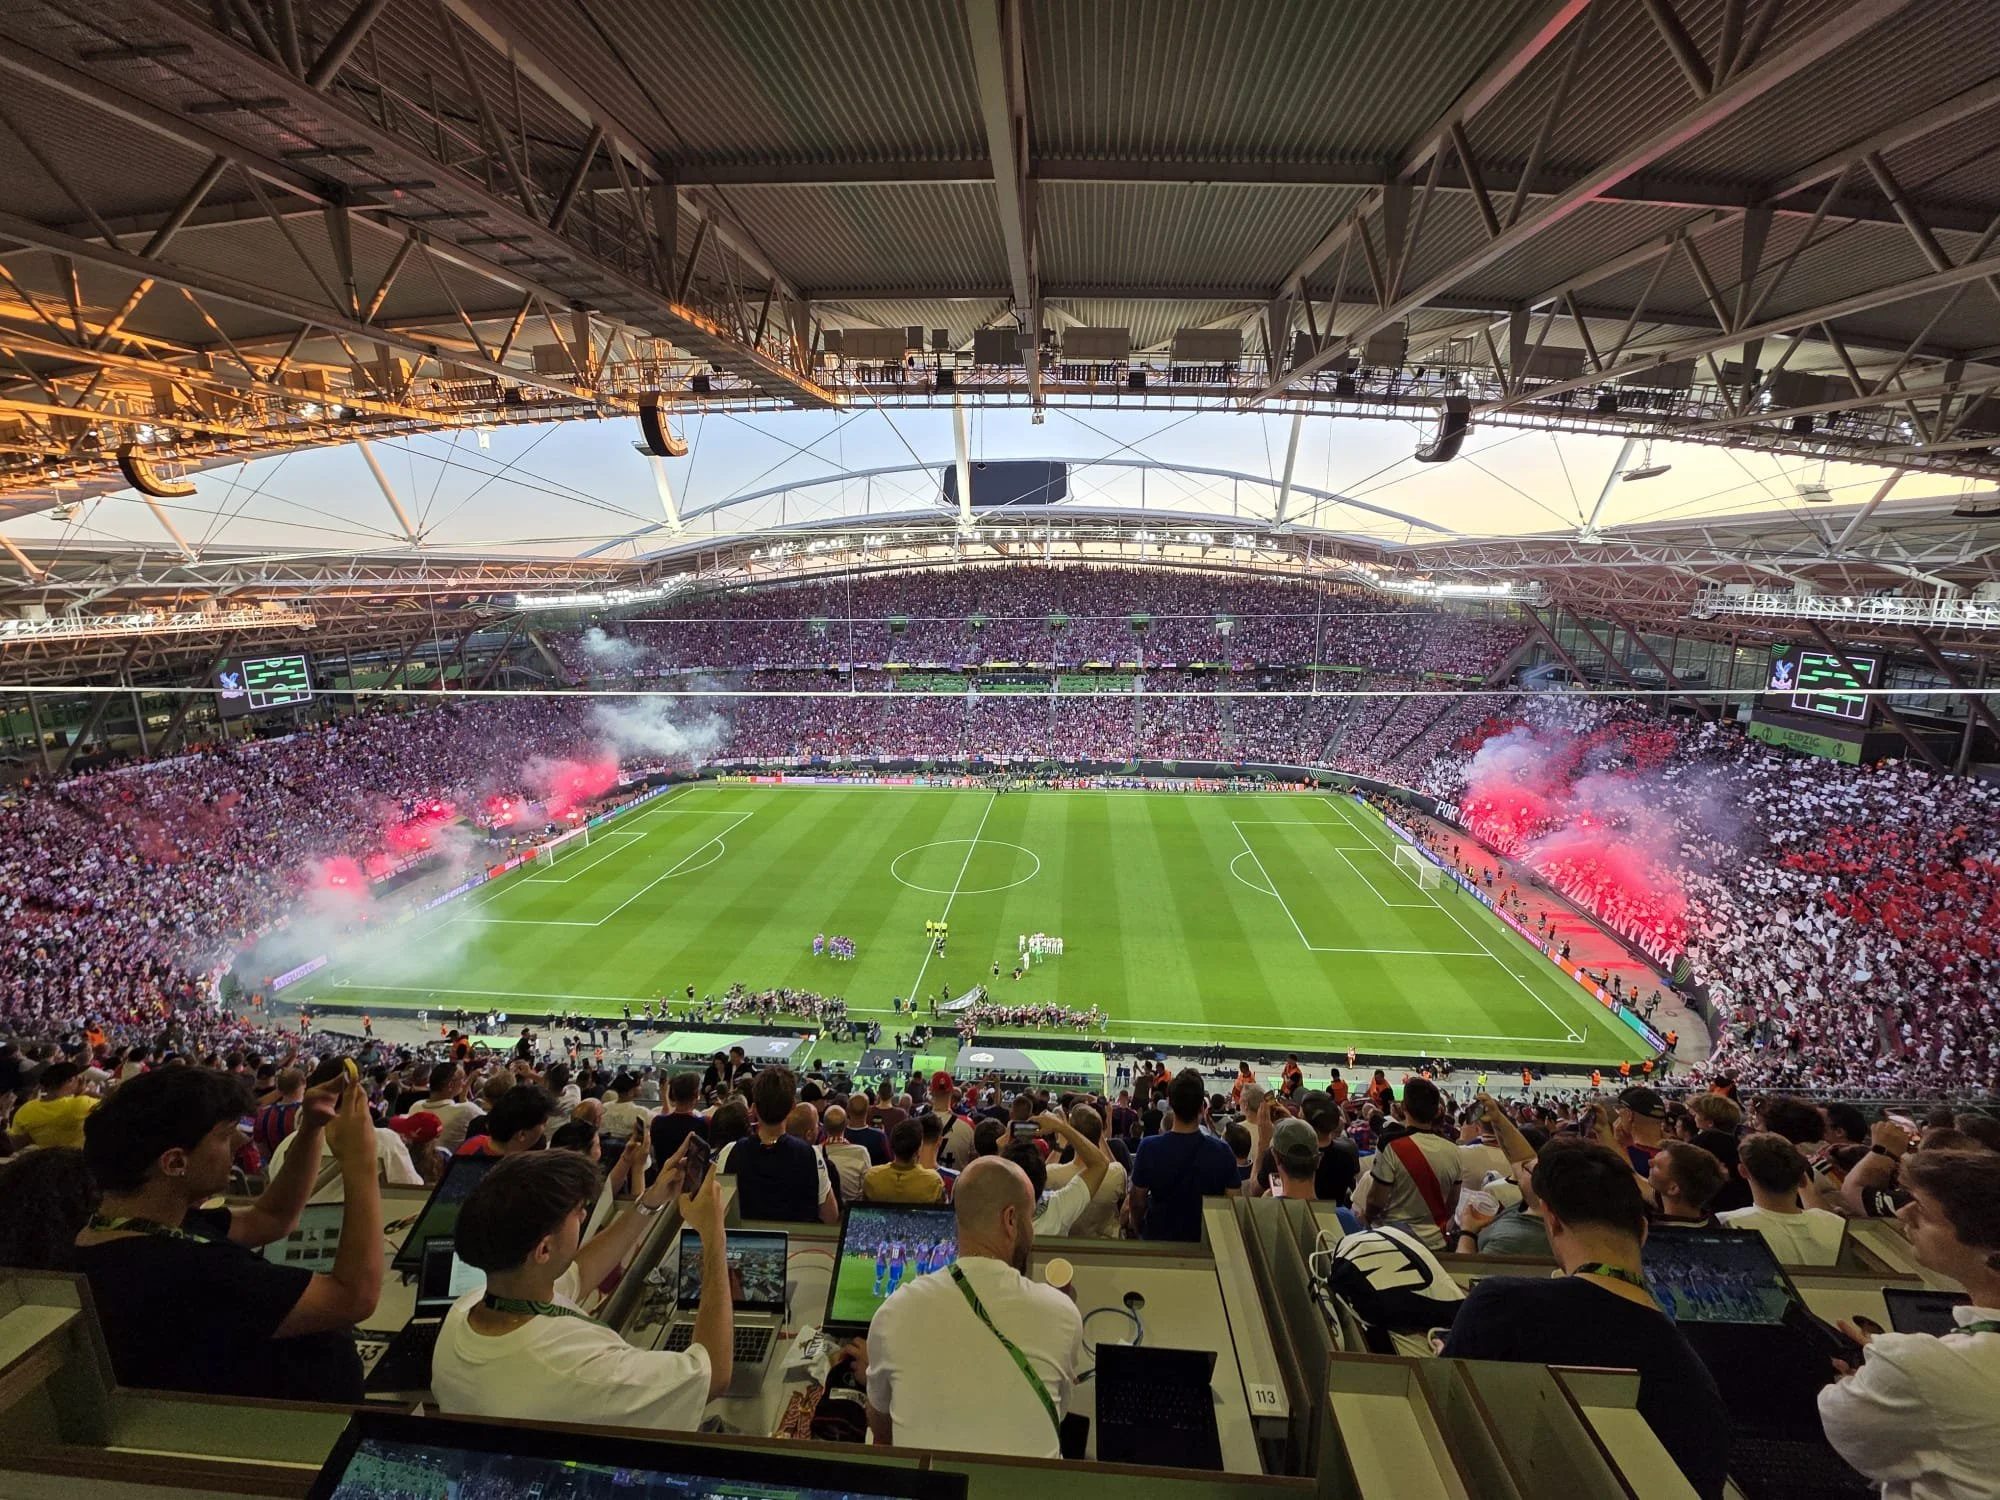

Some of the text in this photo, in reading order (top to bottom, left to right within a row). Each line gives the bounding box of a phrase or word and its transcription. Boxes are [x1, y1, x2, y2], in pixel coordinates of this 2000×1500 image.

[1783, 731, 1820, 746] LEIPZIG
[1435, 801, 1460, 821] POR
[1459, 810, 1475, 831] LA
[1561, 876, 1600, 916] VIDA
[1602, 903, 1680, 974] ENTERA
[1255, 1390, 1276, 1404] 113
